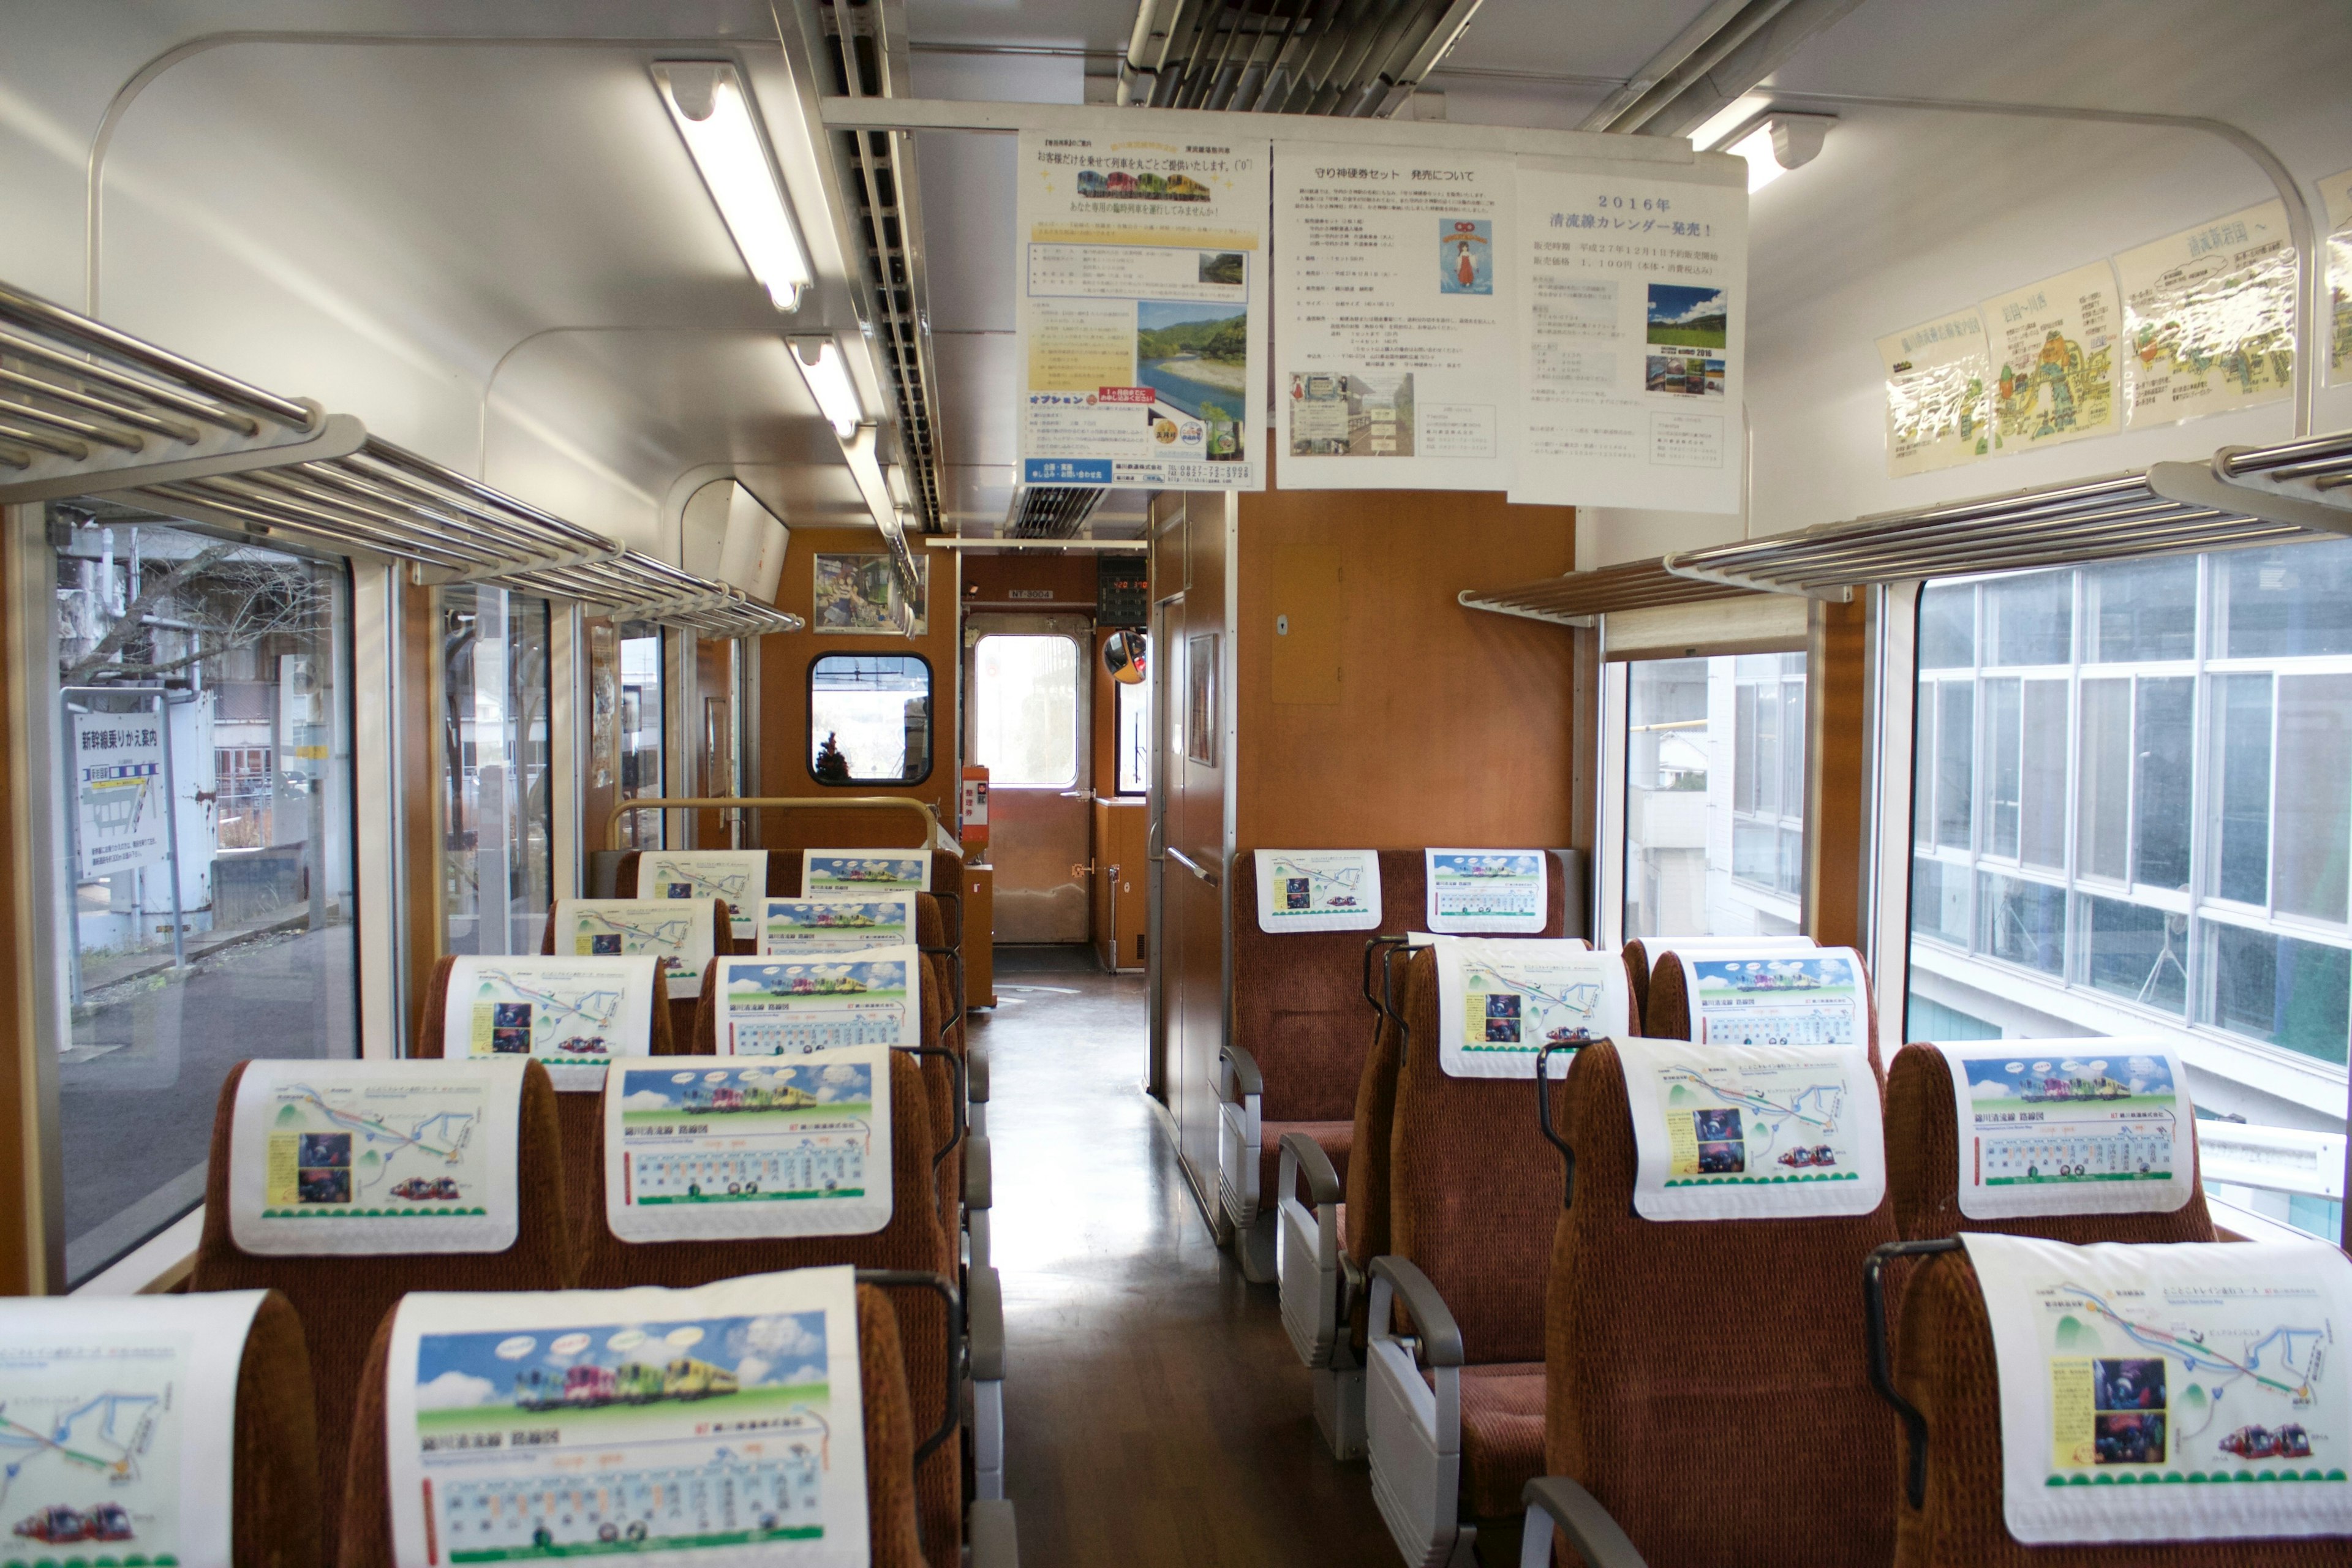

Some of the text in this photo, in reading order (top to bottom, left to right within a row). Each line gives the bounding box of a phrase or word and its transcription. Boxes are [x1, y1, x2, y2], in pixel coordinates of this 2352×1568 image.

[1315, 167, 1474, 181] 守り神硬券セット 発売について
[1598, 195, 1670, 213] 2016年
[1549, 212, 1711, 237] 清流線カレンダー発売！
[1696, 349, 1713, 358] 2016
[1030, 395, 1084, 405] オプション
[82, 728, 157, 750] 新幹線乗りかえ案内
[1974, 1111, 2045, 1122] 錦川清流線 路線図
